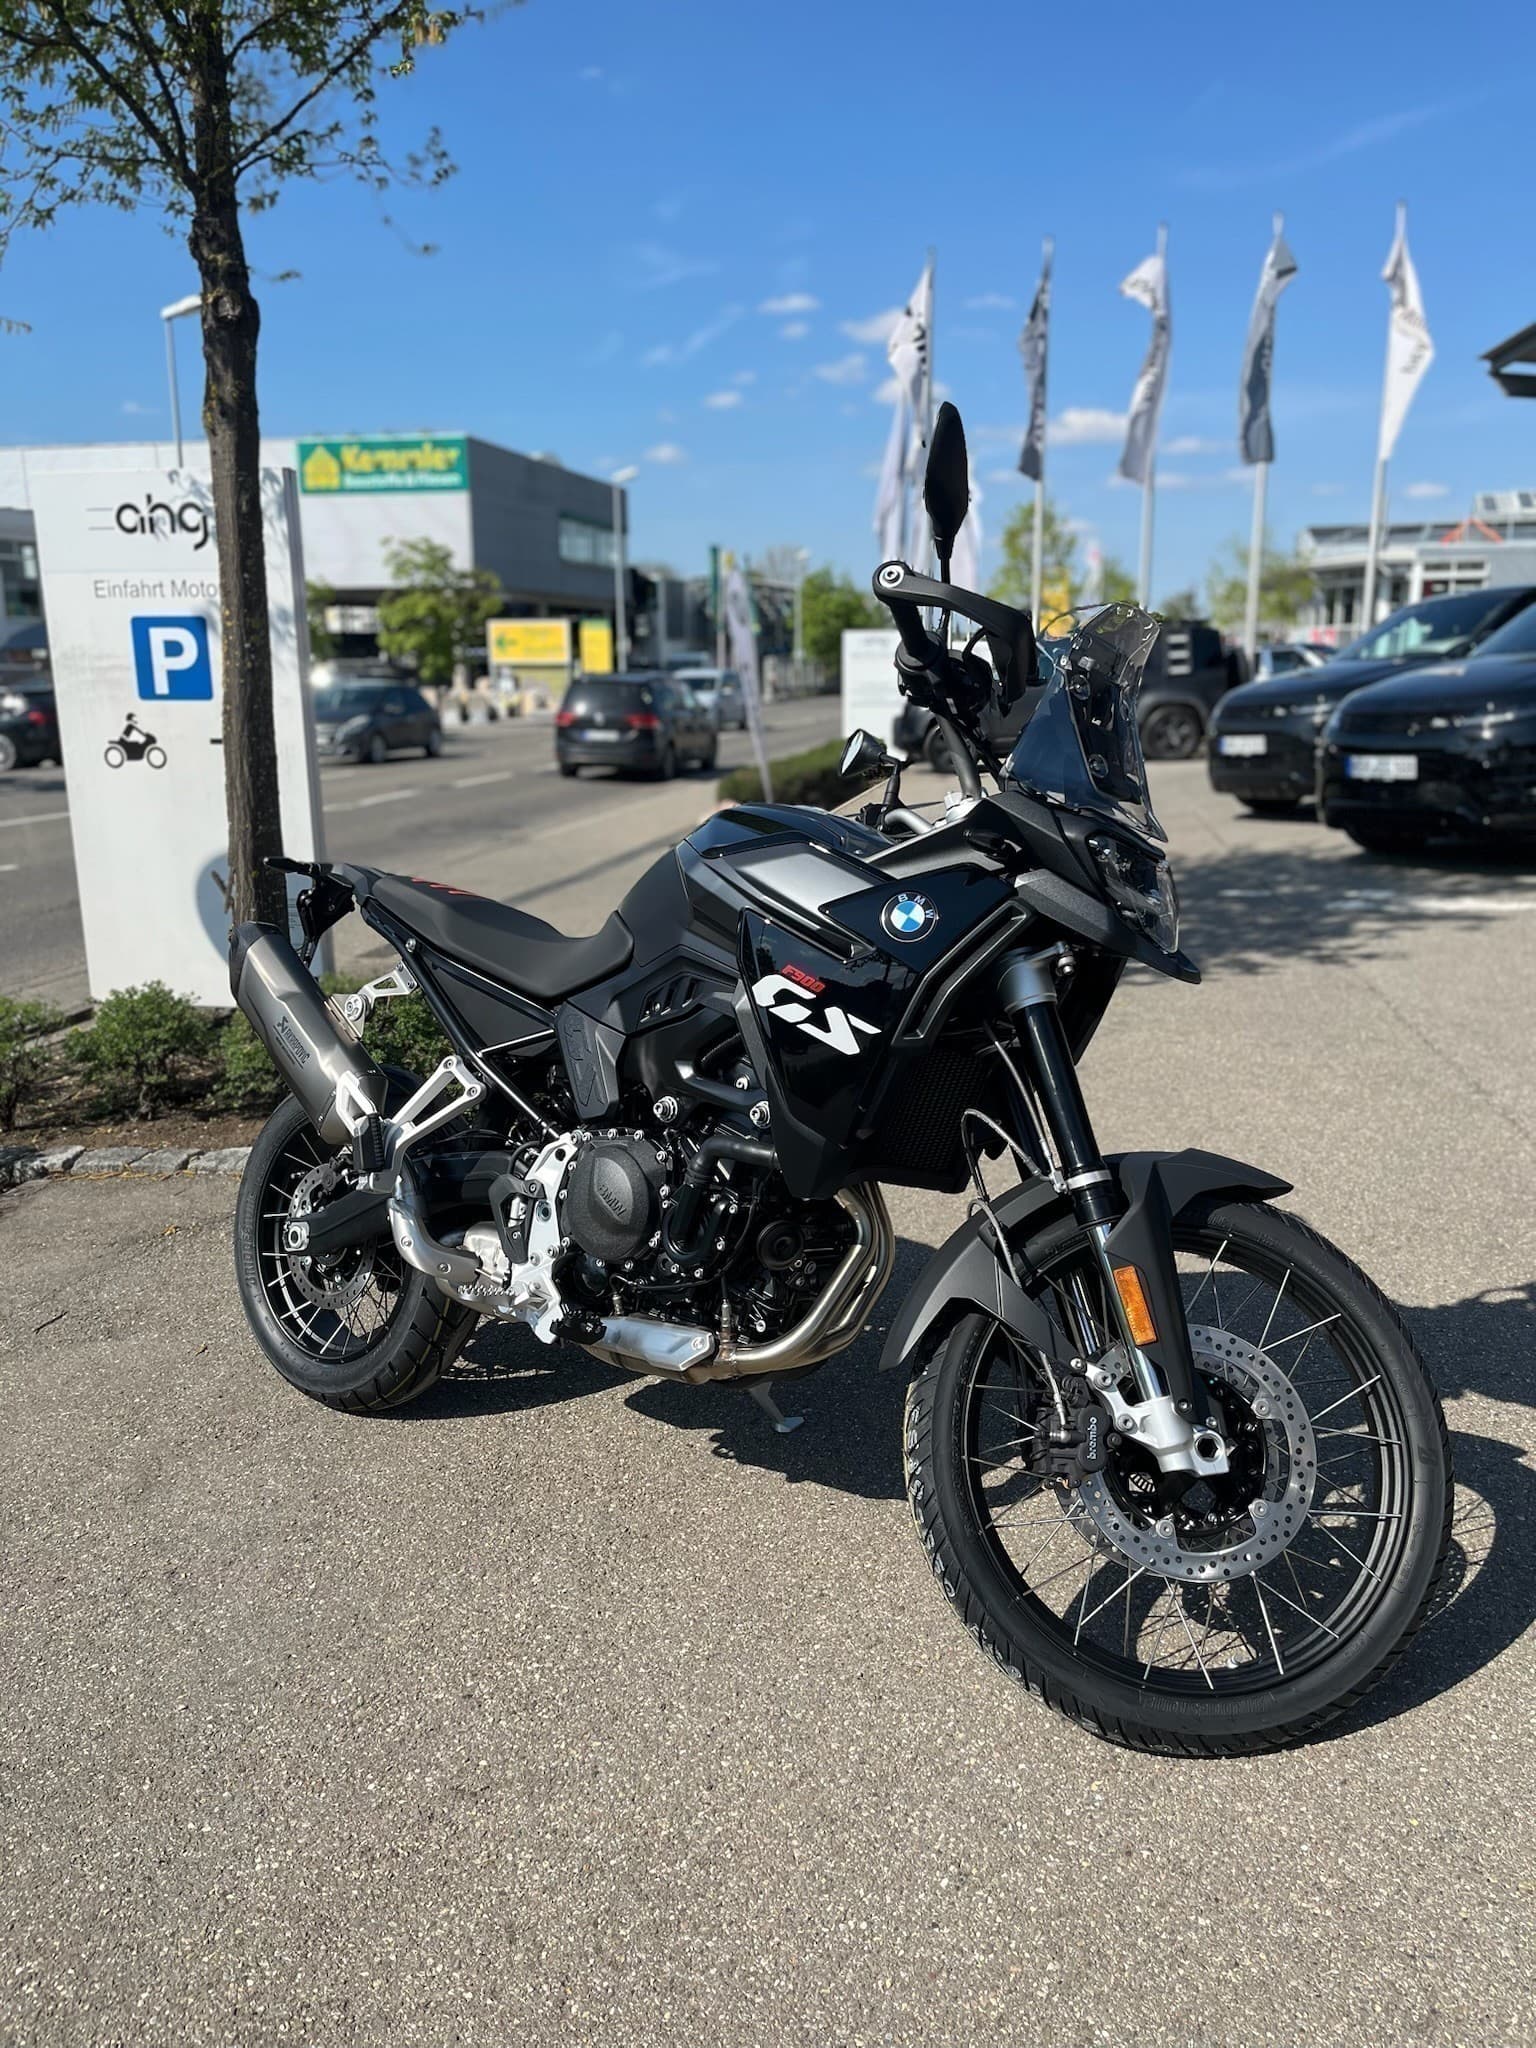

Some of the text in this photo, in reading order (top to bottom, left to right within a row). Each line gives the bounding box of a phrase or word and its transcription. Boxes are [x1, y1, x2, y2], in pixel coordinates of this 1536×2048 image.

[93, 579, 219, 599] Einfahrt Moto
[148, 626, 199, 696] P
[897, 892, 935, 919] BMW
[781, 963, 827, 993] F900
[1086, 1416, 1098, 1460] brembo
